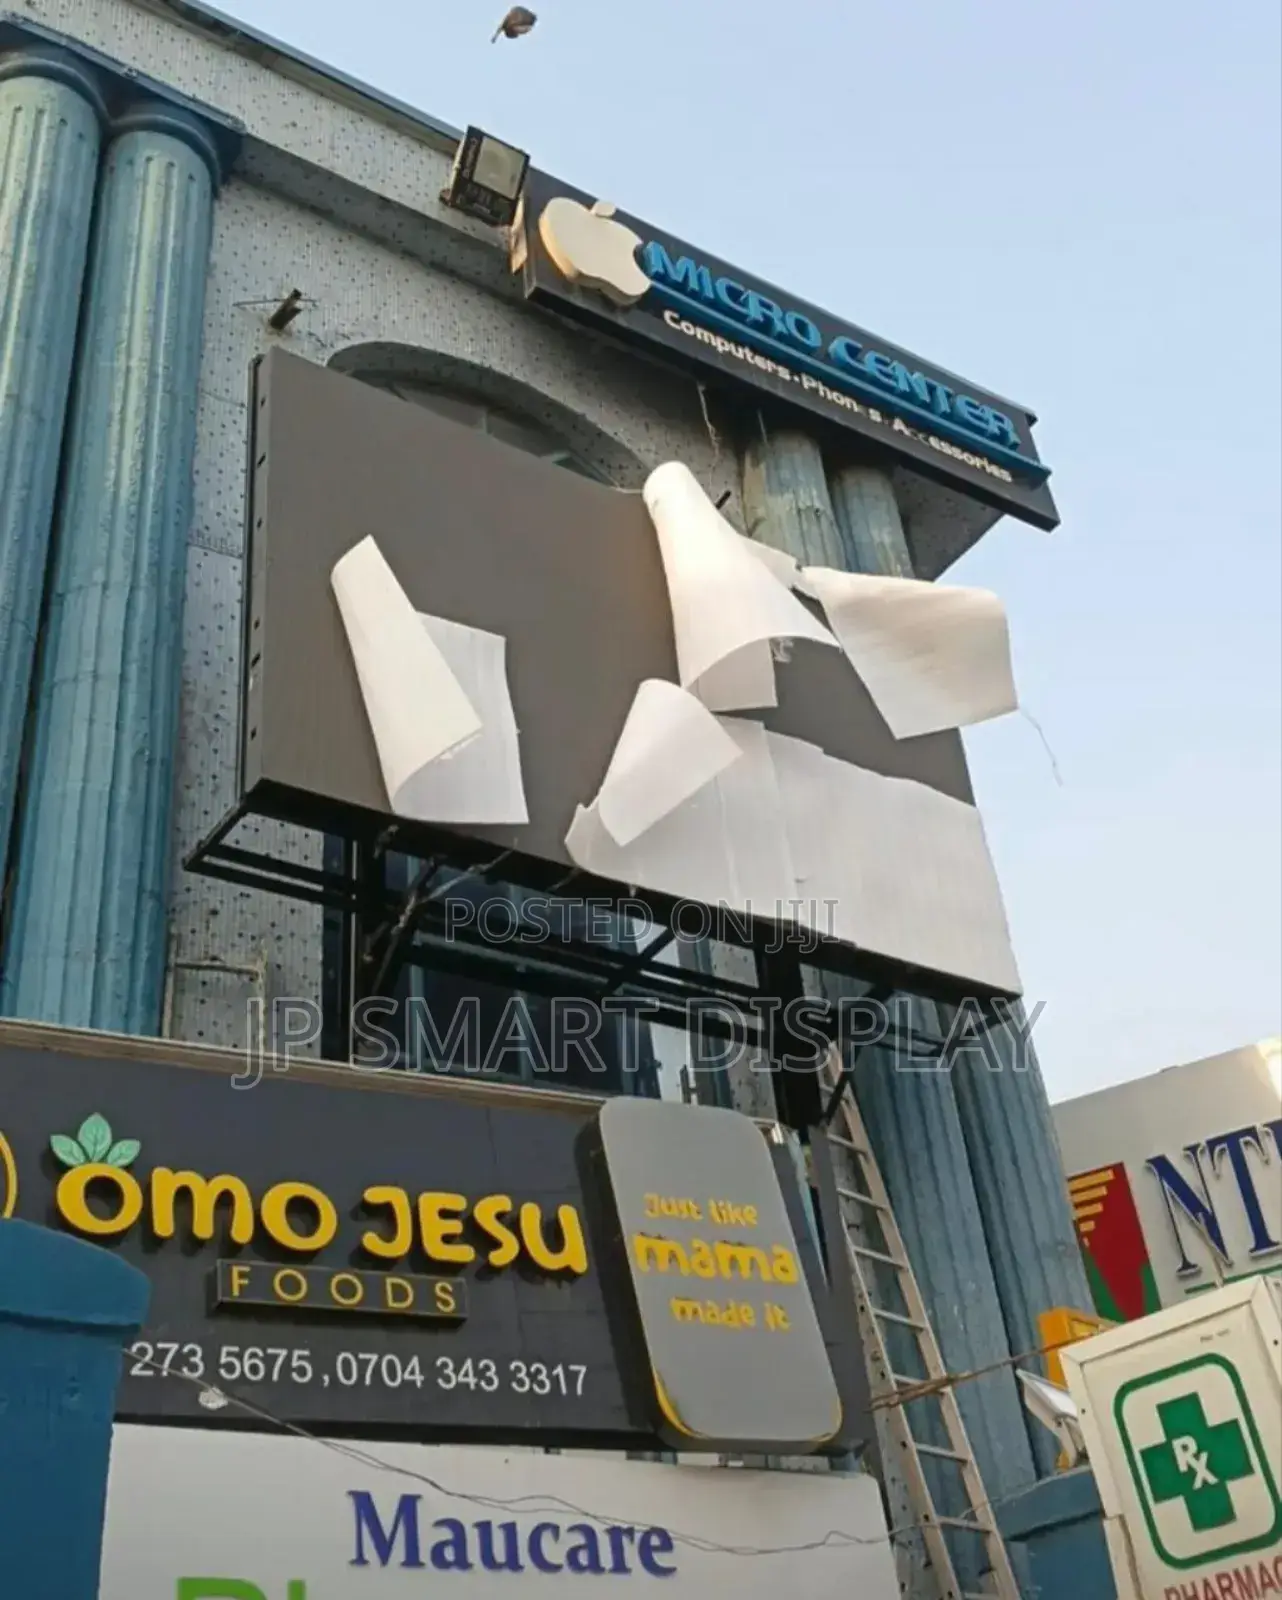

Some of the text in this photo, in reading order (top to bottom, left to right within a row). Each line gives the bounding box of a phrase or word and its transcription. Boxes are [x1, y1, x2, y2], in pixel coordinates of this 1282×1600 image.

[643, 240, 1020, 450] MICRO CENTER
[708, 1198, 758, 1227] like
[1145, 1118, 1282, 1276] NT
[632, 1233, 799, 1284] mama
[231, 1265, 456, 1313] FOODS
[670, 1296, 791, 1332] made it
[129, 1341, 205, 1379] 273
[435, 1356, 499, 1393] 343
[509, 1360, 588, 1397] 3317
[347, 1490, 677, 1576] Maucare
